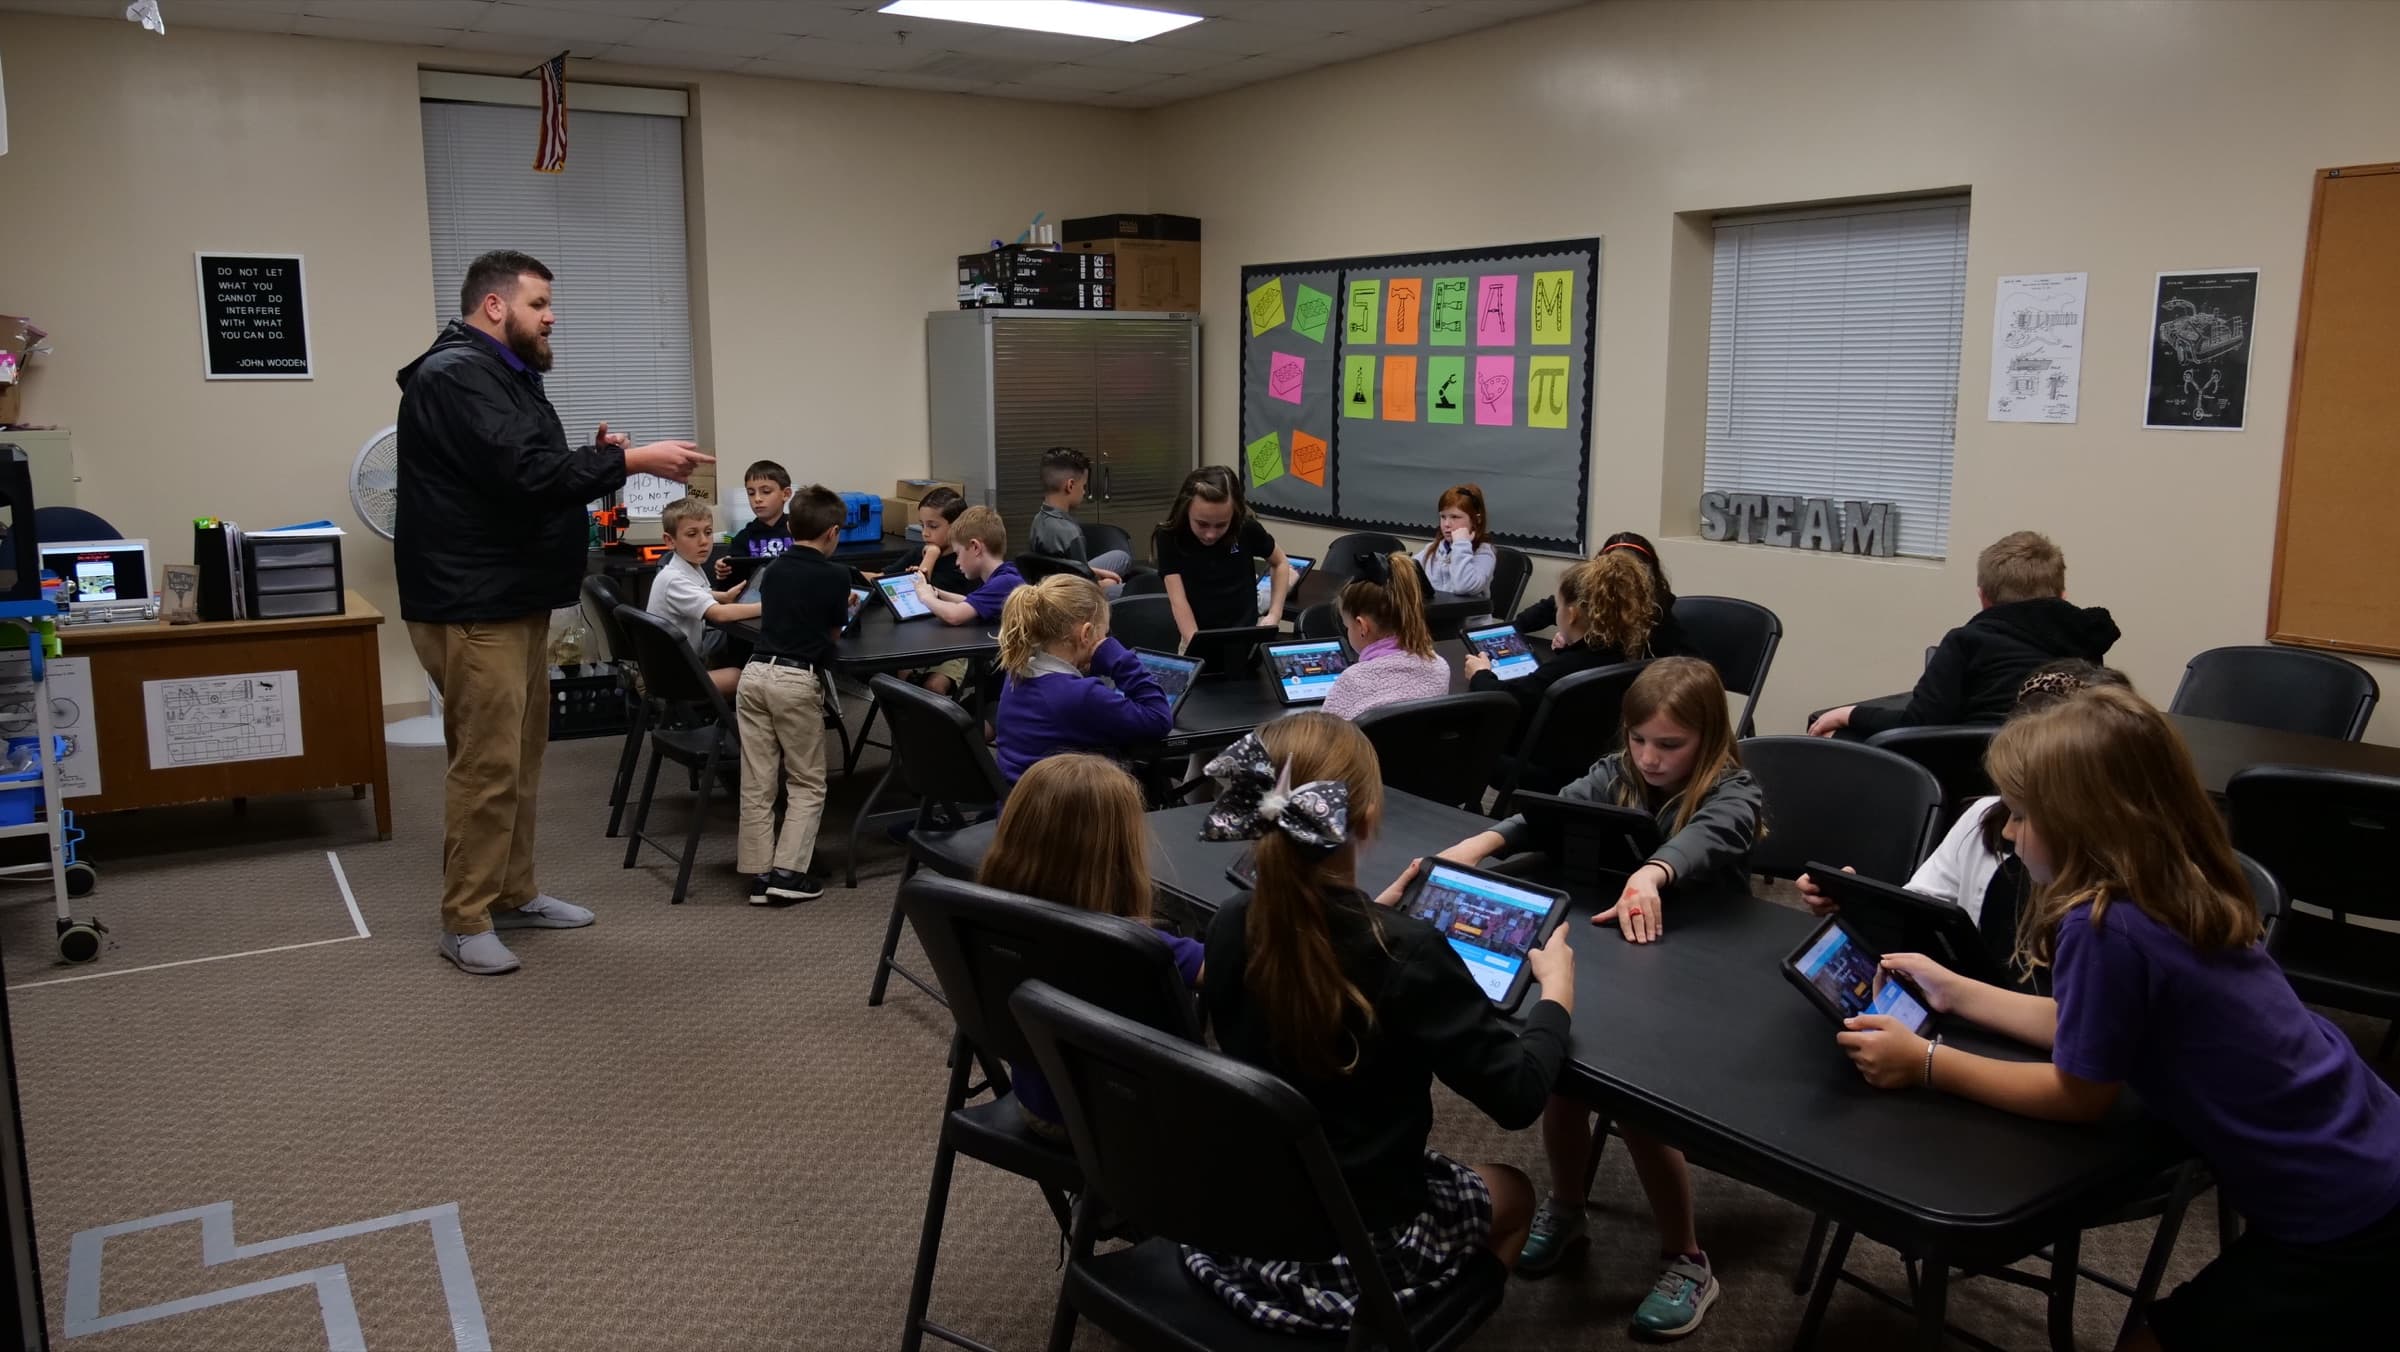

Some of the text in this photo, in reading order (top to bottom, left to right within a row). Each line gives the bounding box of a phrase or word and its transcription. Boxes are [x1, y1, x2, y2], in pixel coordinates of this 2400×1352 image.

[217, 267, 283, 277] DO NOT LET
[218, 281, 273, 291] WHAT YOU
[217, 294, 283, 303] CANNOT DO
[226, 306, 281, 315] INTERFERE
[220, 319, 283, 327] WITH WHAT
[221, 331, 285, 340] YOU CAN DO.
[266, 358, 306, 367] WOODEN
[629, 491, 670, 503] DO NOT
[1700, 490, 1896, 557] STEAM
